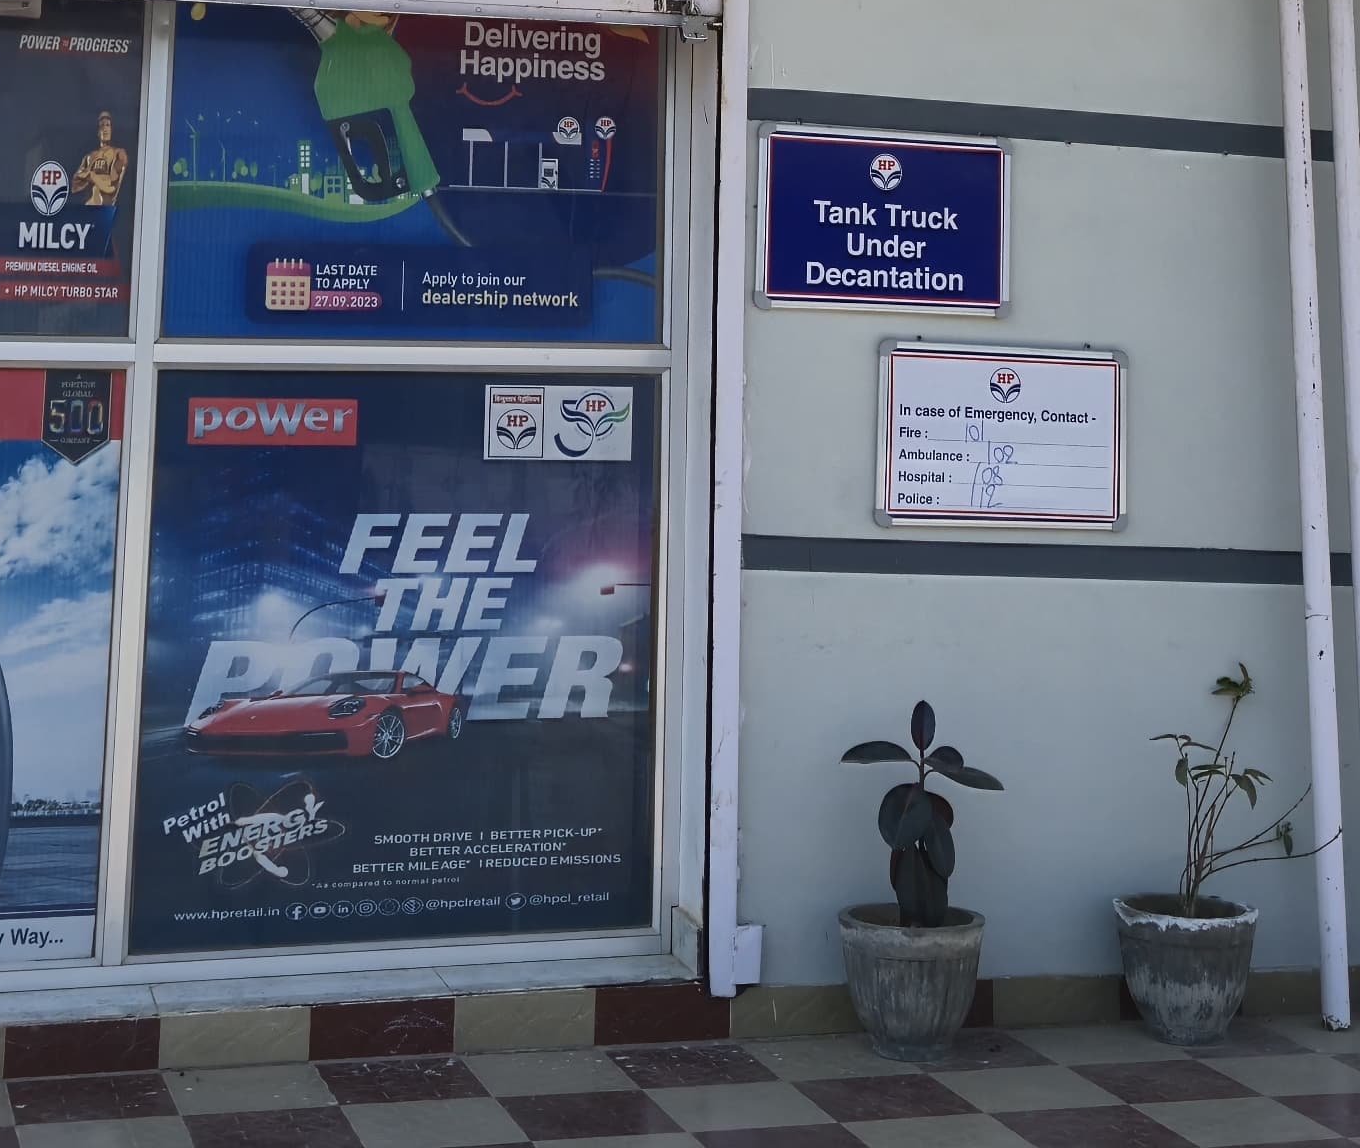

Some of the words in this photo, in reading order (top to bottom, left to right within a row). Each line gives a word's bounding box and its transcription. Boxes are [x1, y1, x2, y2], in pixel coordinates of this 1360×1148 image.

[20, 35, 60, 50] POWER
[69, 37, 129, 54] PROGRESS
[465, 21, 601, 59] Delivering
[460, 50, 605, 84] Happiness
[877, 160, 895, 171] HP
[41, 170, 61, 186] HP
[814, 199, 877, 226] Tank
[885, 203, 959, 230] Truck
[19, 222, 90, 250] MILCY
[847, 233, 926, 259] Under
[316, 264, 346, 276] LAST
[348, 265, 377, 277] DATE
[422, 271, 458, 287] Apply
[462, 273, 474, 285] to
[477, 273, 501, 287] join
[503, 275, 526, 286] our
[806, 261, 964, 291] Decantation
[14, 286, 28, 297] HP
[30, 286, 59, 297] MILCY
[61, 287, 92, 298] TURBO
[94, 287, 118, 298] STAR
[316, 278, 330, 289] TO
[333, 279, 370, 290] APPLY
[314, 296, 378, 308] 27.09.2023
[422, 289, 508, 308] dealership
[513, 292, 578, 307] network
[997, 373, 1015, 384] HP
[585, 400, 607, 412] HP
[900, 404, 911, 416] In
[915, 406, 945, 418] case
[948, 405, 961, 418] of
[965, 407, 1037, 423] Emergency,
[1041, 411, 1089, 423] Contact
[49, 399, 104, 434] 500
[507, 415, 529, 427] HP
[899, 427, 921, 438] Fire
[965, 420, 984, 443] 101
[898, 449, 963, 462] Ambulance
[987, 441, 1018, 465] 102
[898, 471, 945, 485] Hospital
[897, 493, 933, 505] Police
[340, 513, 536, 574] FEEL
[374, 578, 513, 631] THE
[163, 792, 226, 835] Petrol
[183, 812, 231, 843] With
[198, 793, 324, 858] ENERGY
[374, 833, 430, 845] SMOOTH
[433, 832, 473, 842] DRIVE
[490, 829, 541, 840] BETTER
[198, 819, 328, 875] BOOSTERS
[409, 846, 460, 857] BETTER
[353, 862, 404, 873] BETTER
[485, 856, 548, 868] REDUCED
[550, 854, 621, 865] EMISSIONS
[174, 906, 280, 921] www.hpretail.in
[425, 896, 500, 910] @hpclretail
[529, 892, 609, 906] @hpcl_retail
[11, 927, 64, 948] Way...
